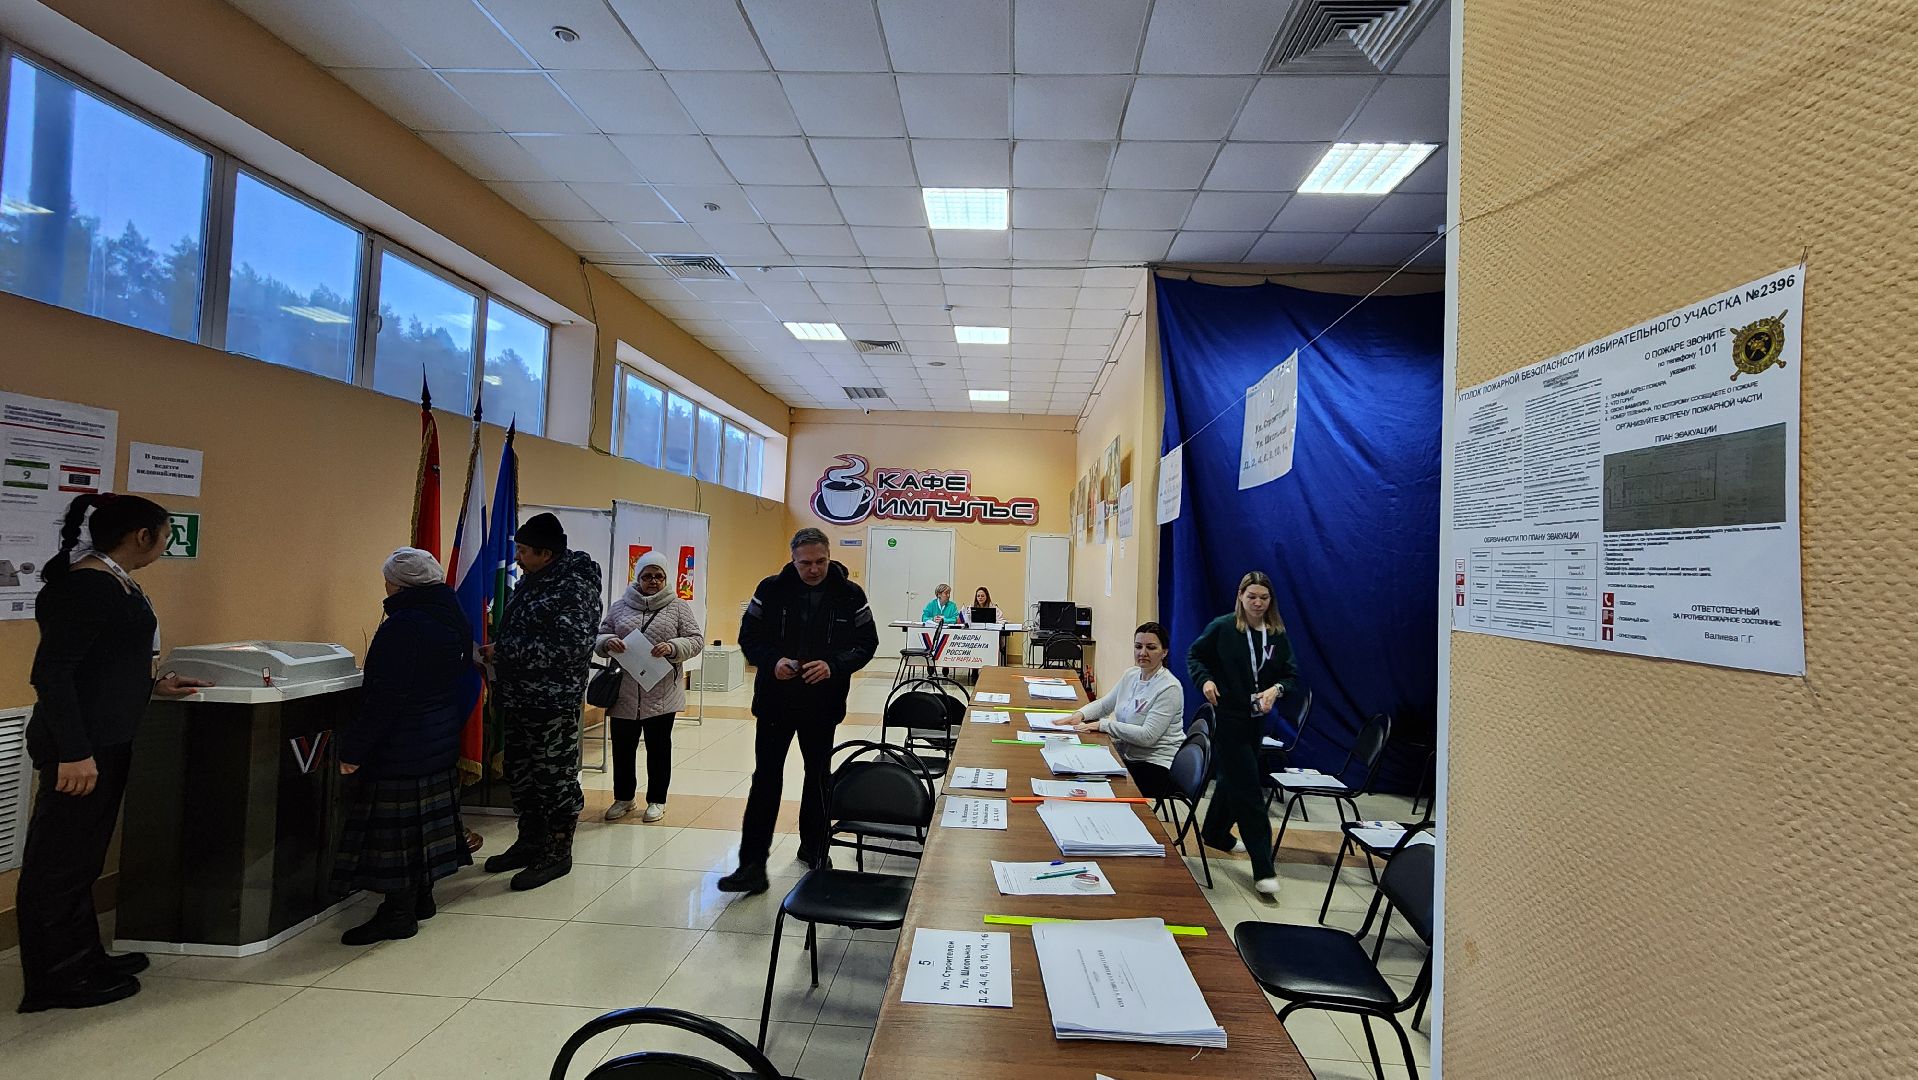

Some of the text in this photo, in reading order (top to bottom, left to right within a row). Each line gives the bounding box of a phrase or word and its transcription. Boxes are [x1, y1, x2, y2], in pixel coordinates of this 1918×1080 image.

[1458, 388, 1483, 402] УГОЛОК
[1482, 373, 1520, 395] ПОЖАРНОЙ
[1521, 350, 1585, 381] БЕЗОПАСНОСТИ
[1587, 316, 1681, 357] ИЗБИРАТЕЛЬНОГО
[1683, 295, 1742, 324] УЧАСТКА
[1745, 274, 1796, 302] №2396
[1644, 327, 1728, 361] О ПОЖАРЕ ЗВОНИТЕ
[1657, 342, 1718, 368] по телефону 101
[1629, 385, 1646, 394] АДРЕС
[1645, 379, 1667, 390] ПОЖАРА
[1653, 403, 1662, 411] ПО
[1661, 397, 1690, 409] КОТОРОМУ
[1690, 387, 1727, 402] СООБЩАЕТЕ
[1726, 386, 1733, 394] О
[1732, 380, 1759, 392] ПОЖАРЕ
[1615, 392, 1763, 431] ОРГАНИЗУЙТЕ ВСТРЕЧУ ПОЖАРНОЙ ЧАСТИ
[1654, 424, 1718, 443] ПЛАН ЭВАКУАЦИИ
[23, 470, 31, 480] 9
[877, 471, 968, 493] КАФЕ
[876, 498, 1035, 520] ИМПУЛЬС
[1519, 534, 1528, 542] ПО
[1528, 533, 1546, 541] ПЛАНУ
[1546, 531, 1580, 542] ЭВАКУАЦИИ
[1672, 612, 1680, 620] ЗА
[1680, 613, 1741, 624] ПРОТИВОПОЖАРНОЕ
[1691, 604, 1760, 616] ОТВЕТСТВЕННЫЙ
[948, 641, 990, 649] ПРЕЗИДЕНТА
[952, 633, 982, 641] ВЫБОРЫ
[1704, 631, 1739, 643] Валиева
[940, 940, 955, 991] Ул. Строителей
[959, 944, 972, 989] Ул. Школьная
